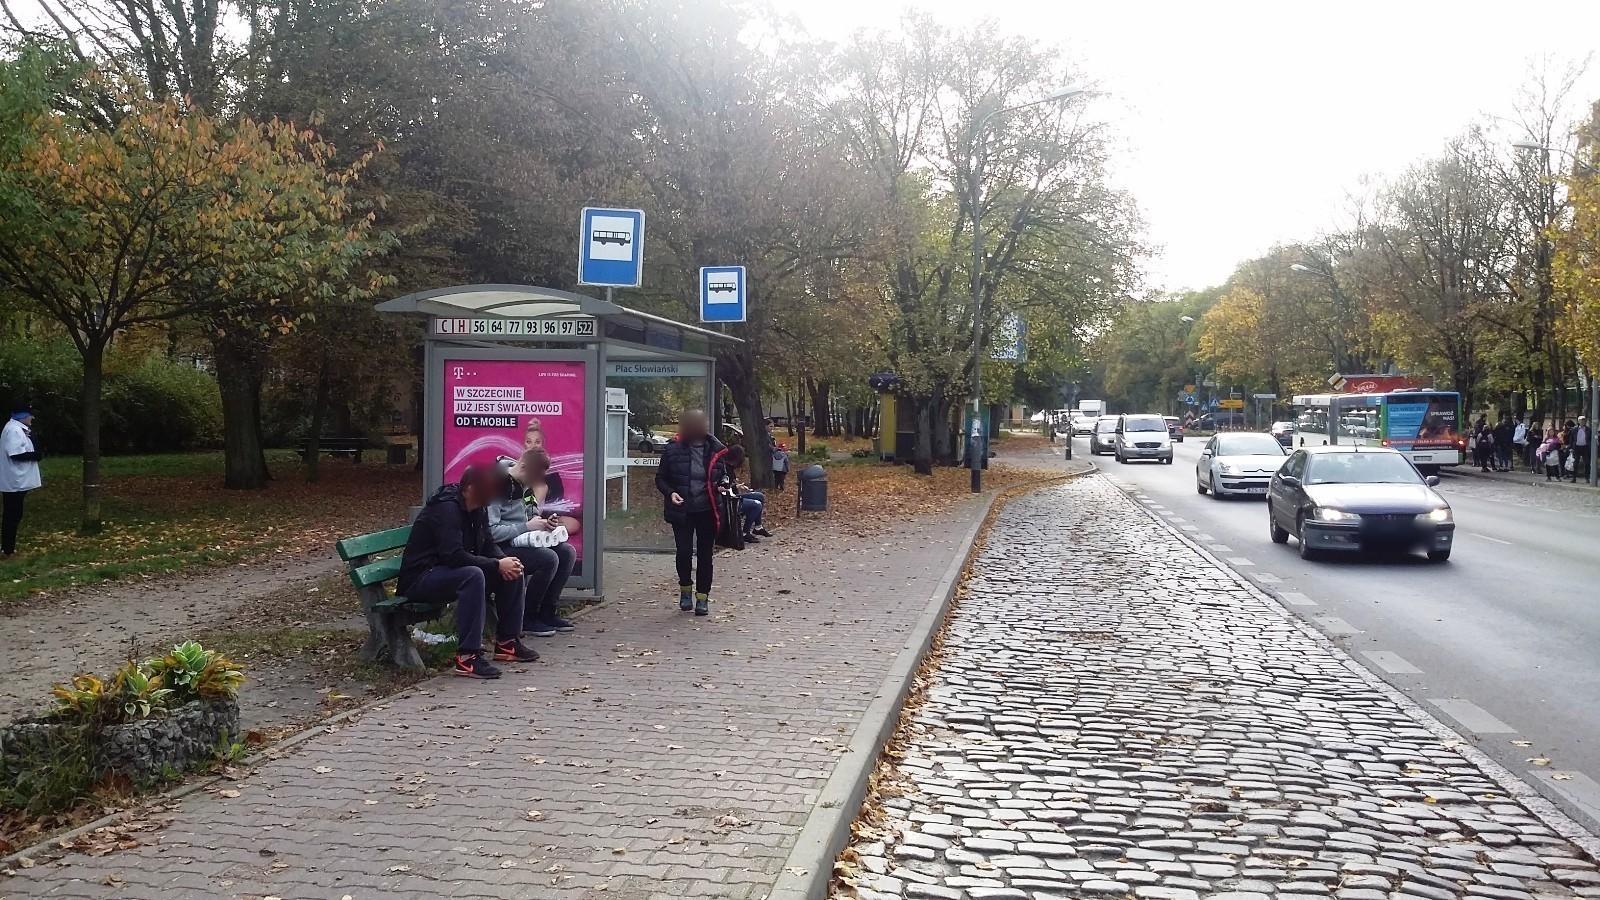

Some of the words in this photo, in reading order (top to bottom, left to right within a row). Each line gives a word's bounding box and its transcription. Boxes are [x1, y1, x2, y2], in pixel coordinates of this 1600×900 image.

[441, 319, 448, 333] C
[458, 319, 465, 333] H
[473, 320, 485, 333] 56
[491, 320, 503, 333] 64
[509, 320, 520, 333] 77
[526, 321, 538, 333] 93
[544, 321, 556, 333] 96
[561, 321, 573, 333] 97
[577, 321, 593, 334] 522
[615, 364, 633, 373] Plac
[456, 389, 465, 397] W
[467, 389, 522, 398] SZCZECINIE
[456, 402, 472, 412] JUŻ
[474, 403, 495, 412] JEST
[497, 402, 560, 413] ŚWIATŁOWÓD
[456, 417, 470, 426] OD
[472, 417, 516, 427] T-MOBILE
